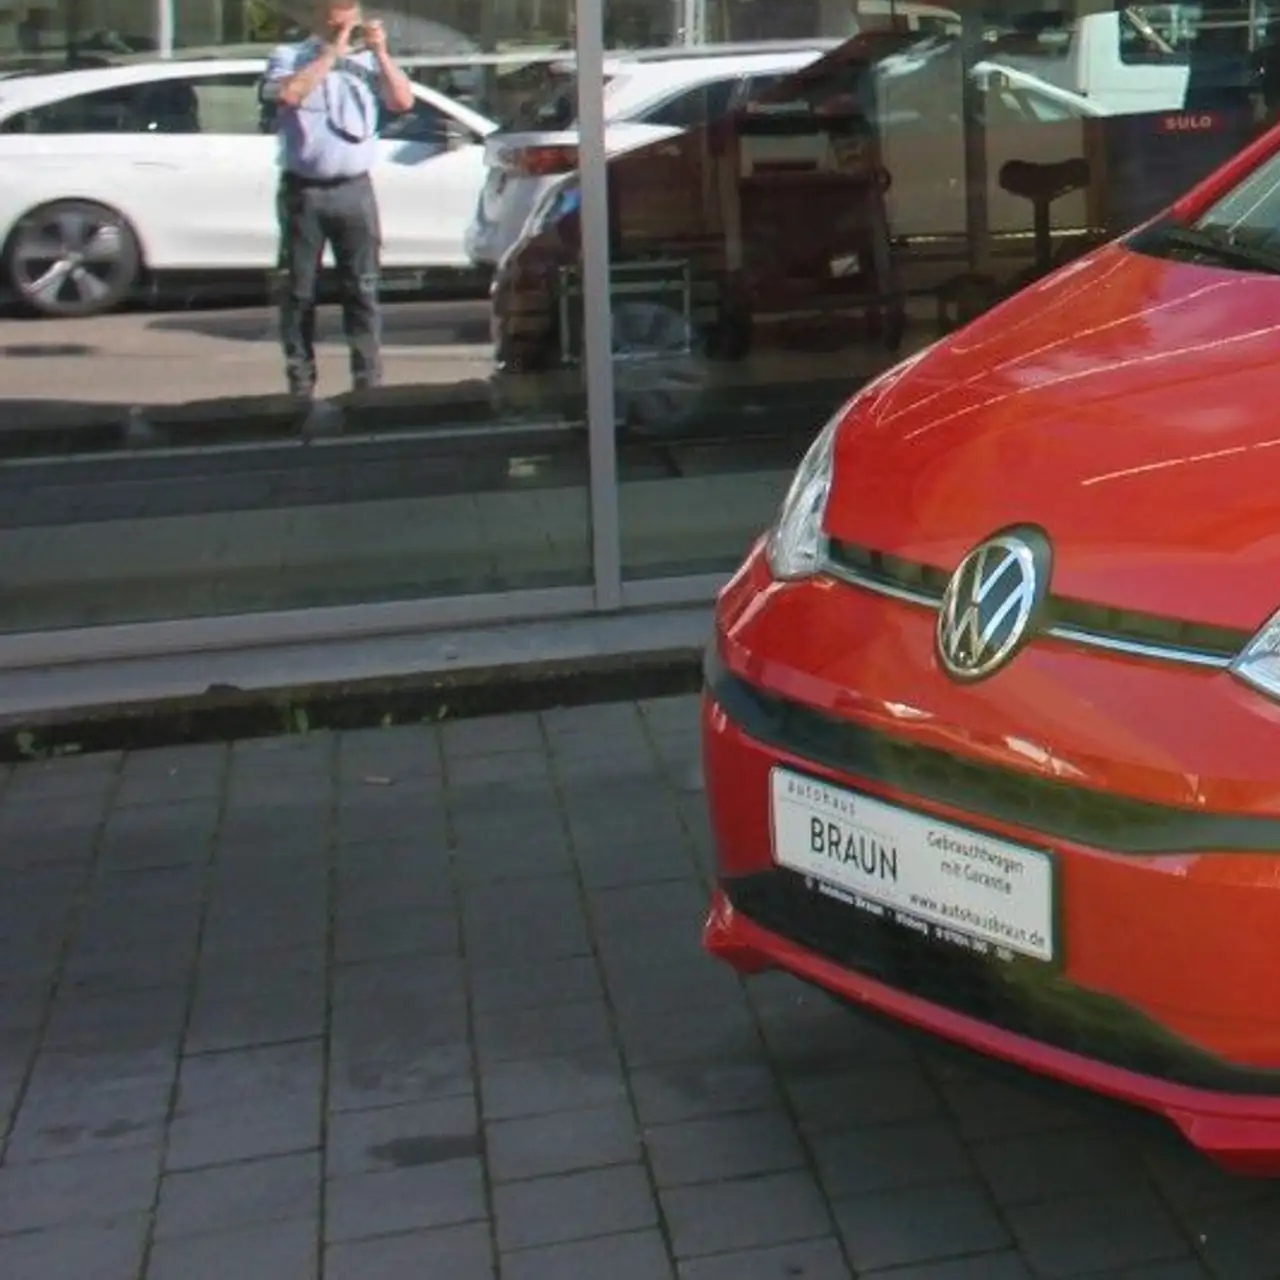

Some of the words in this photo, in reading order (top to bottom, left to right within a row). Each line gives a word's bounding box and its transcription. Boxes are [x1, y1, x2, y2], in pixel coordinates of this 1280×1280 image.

[1164, 115, 1213, 130] SULO
[809, 817, 899, 884] BRAUN
[940, 858, 962, 879] mit
[964, 864, 1013, 896] Garantie
